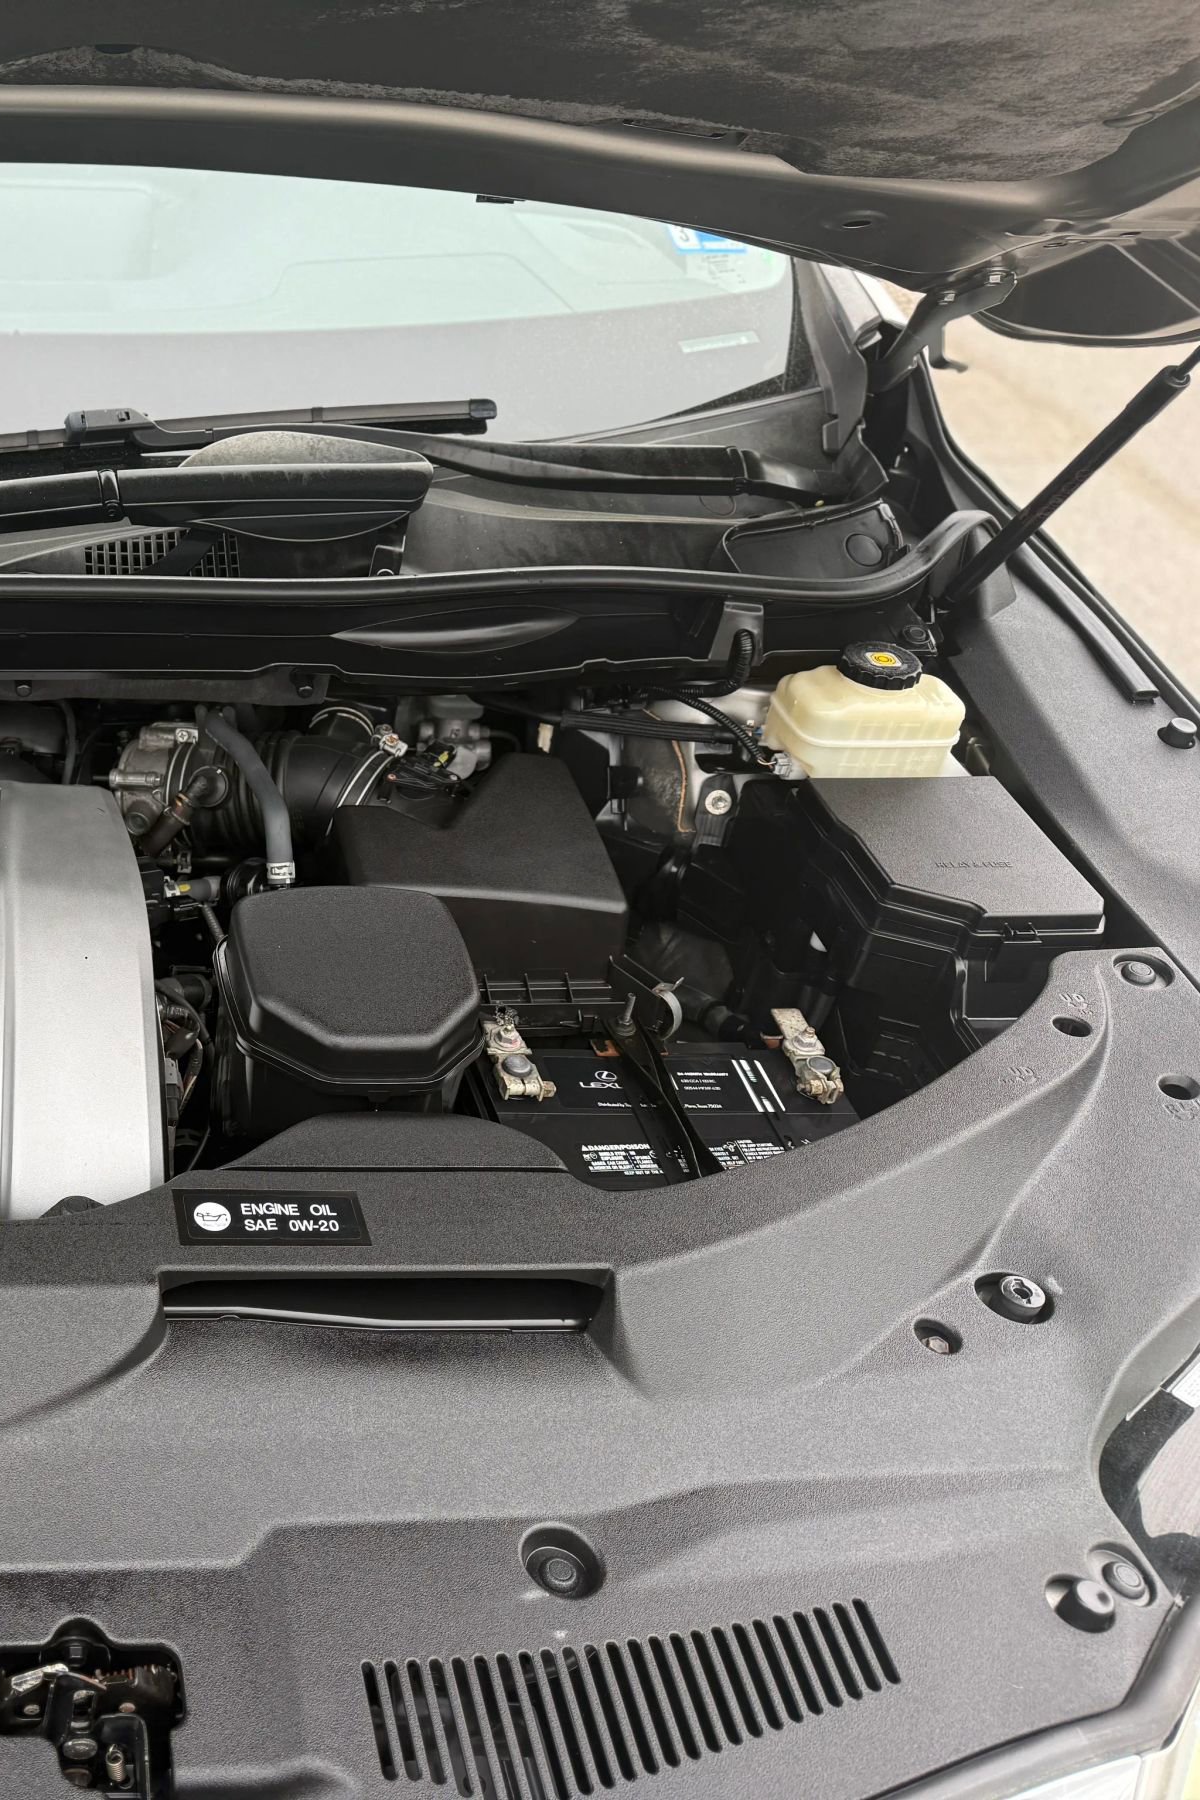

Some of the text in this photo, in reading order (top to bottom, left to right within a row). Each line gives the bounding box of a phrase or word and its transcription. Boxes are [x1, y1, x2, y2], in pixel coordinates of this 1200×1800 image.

[240, 1202, 337, 1216] ENGINE OIL
[244, 1219, 339, 1232] SAE 0W-20
